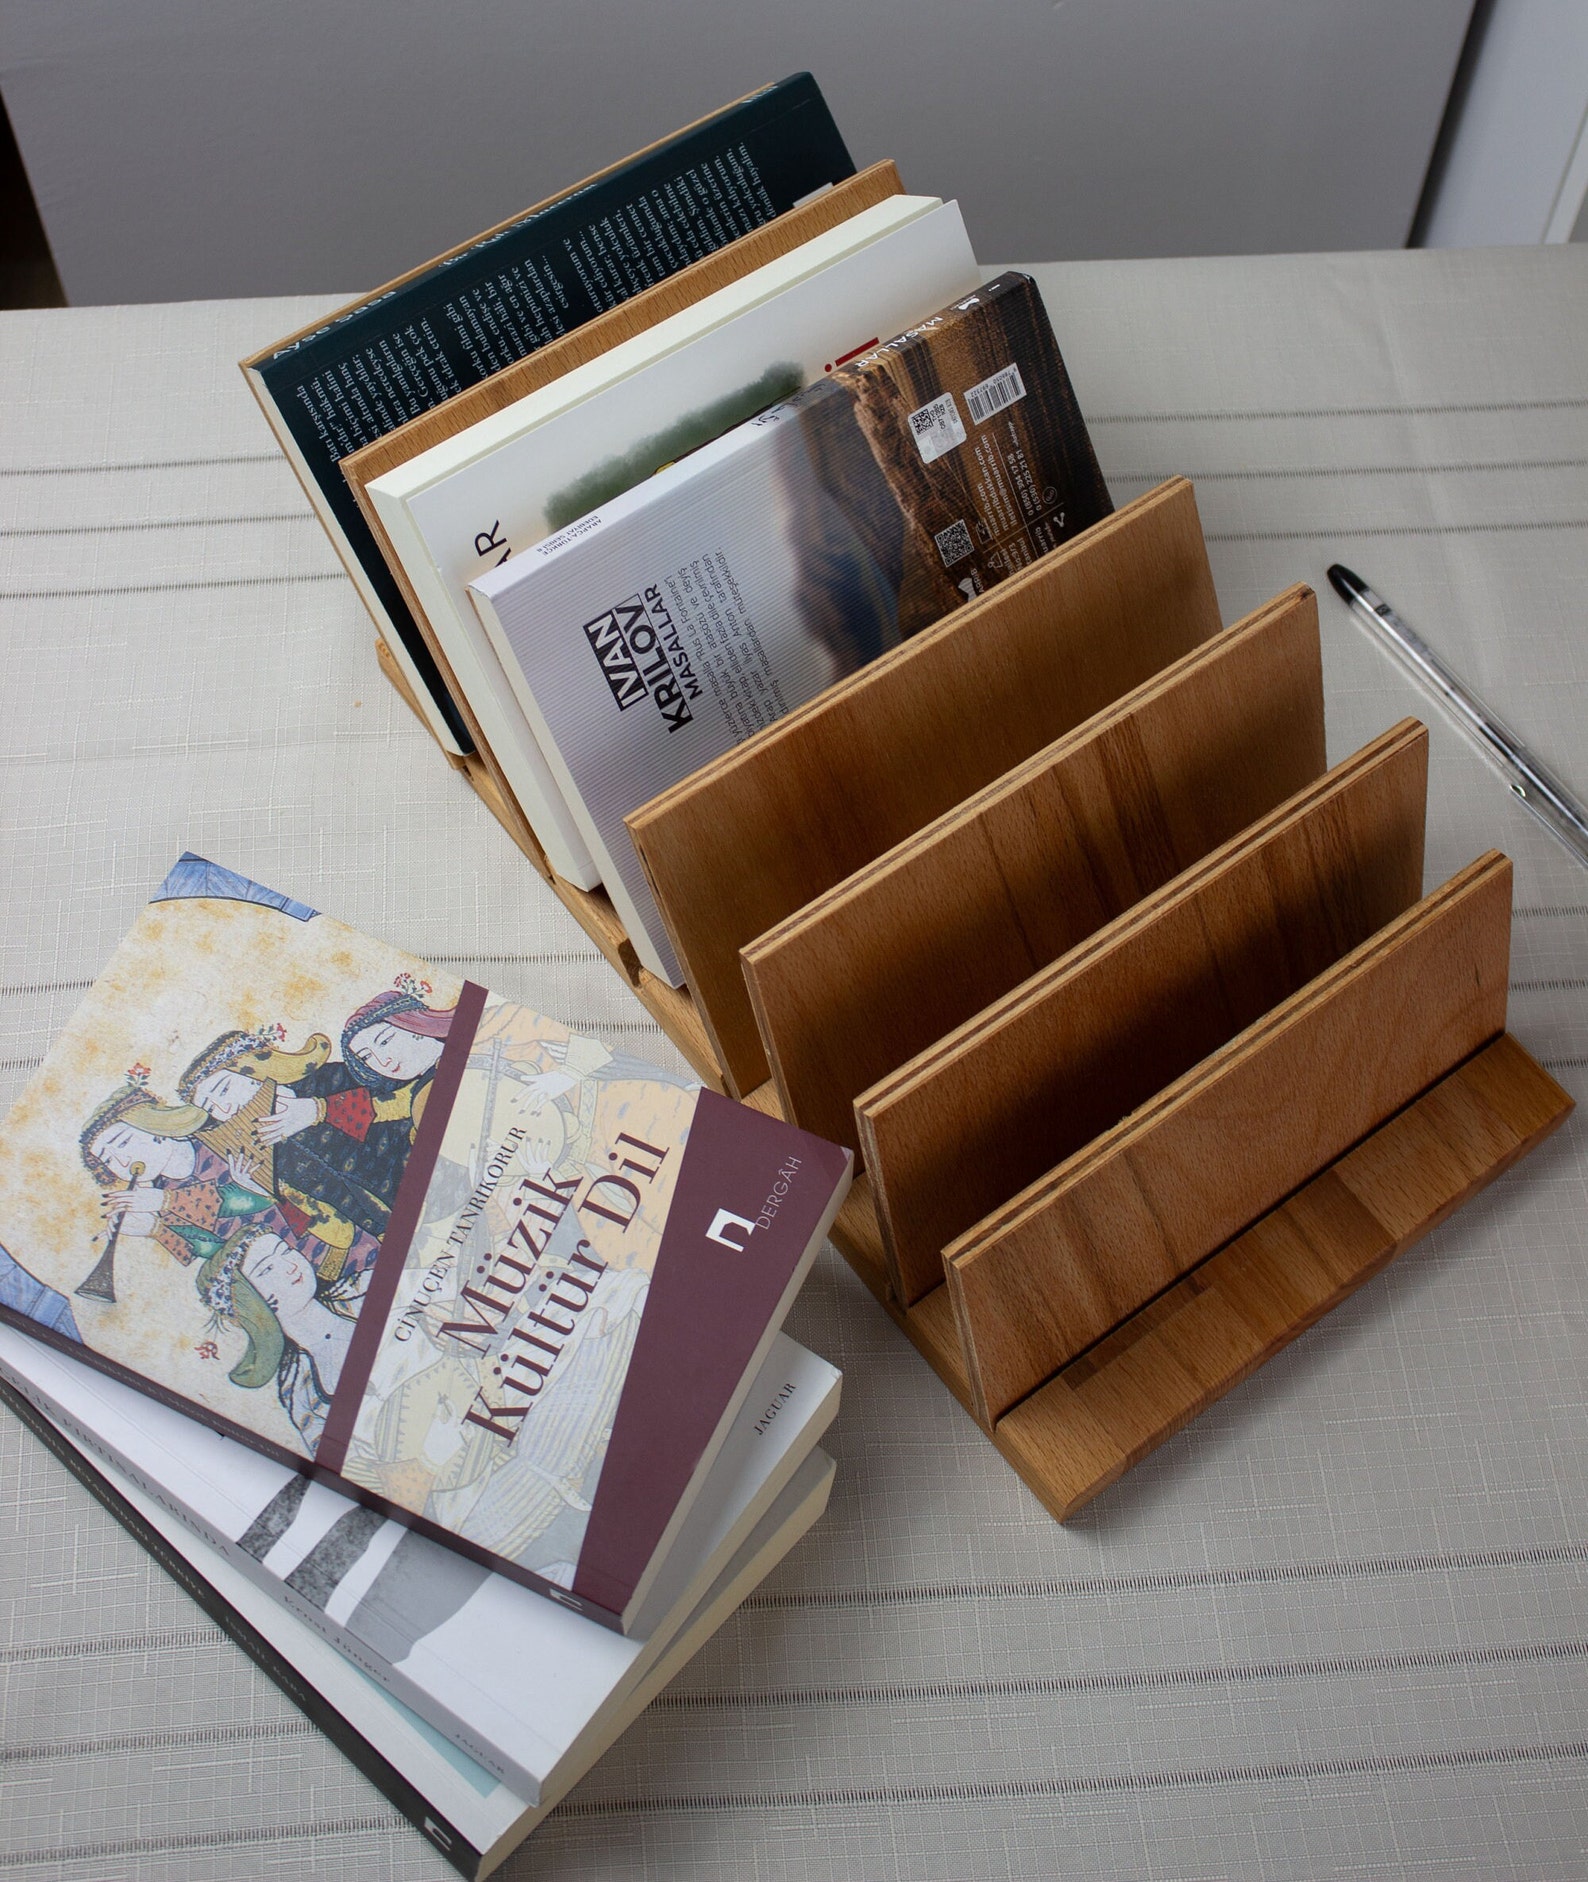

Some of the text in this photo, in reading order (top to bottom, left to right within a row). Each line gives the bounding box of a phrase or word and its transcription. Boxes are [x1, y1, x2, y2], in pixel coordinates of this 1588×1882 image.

[651, 189, 659, 197] o
[673, 175, 699, 216] Şimdiki
[685, 169, 708, 196] güzel
[700, 162, 722, 200] üzerine
[714, 155, 741, 208] kılıyorum.
[726, 148, 760, 209] yolculuğum,
[738, 142, 776, 217] dönük hayalim.
[655, 198, 670, 220] ama
[663, 183, 699, 248] eda edebilme
[702, 197, 709, 205] o
[599, 217, 629, 260] yolculuk
[612, 209, 640, 258] üzümleri,
[626, 203, 666, 277] tam bir cennet
[638, 196, 678, 268] çocukluğumda
[511, 266, 521, 280] ve
[563, 238, 603, 312] oturuyorum ve
[579, 231, 607, 288] ediyorum...
[588, 224, 622, 287] kurar; bense
[472, 288, 482, 302] ve
[484, 282, 497, 299] bir
[524, 259, 555, 313] azaplardan
[542, 255, 569, 308] esirgesin...
[443, 302, 463, 323] gibi
[459, 295, 490, 352] bulamayan
[479, 302, 500, 335] endişe
[497, 274, 540, 343] gibi ve en ağır
[515, 280, 544, 327] hepimizi
[404, 325, 421, 345] çok
[420, 317, 439, 349] ettim.
[454, 324, 473, 350] filmi
[855, 316, 943, 370] MASALLAR
[337, 362, 355, 388] hınç
[352, 354, 382, 399] yaydılar;
[365, 347, 396, 398] neredeyse
[379, 339, 421, 414] Bu yanılgıların
[392, 333, 428, 397] Gerçeğin ise
[415, 346, 434, 367] pek
[434, 350, 454, 379] idrak
[310, 377, 336, 420] hükmü,
[322, 370, 362, 437] biçimi halini
[350, 387, 374, 423] altında
[296, 385, 341, 462] Batı karşısında
[974, 446, 1008, 530] muarribdukkan.com
[979, 482, 1000, 536] muarrib.com
[677, 567, 693, 593] deyiş
[689, 559, 714, 602] çevrilmiş
[690, 596, 700, 610] ve
[707, 602, 720, 621] dile
[724, 607, 742, 637] Anton
[644, 584, 703, 700] MASALLAR
[686, 623, 697, 638] La
[695, 612, 718, 650] atasözü
[715, 620, 729, 644] fazla
[744, 618, 774, 678] masallardan
[588, 614, 645, 706] IVAN
[615, 598, 692, 733] KRILOV
[702, 661, 722, 697] masalla
[713, 653, 724, 668] bir
[724, 642, 743, 675] elliden
[719, 668, 741, 701] büyük
[749, 670, 769, 696] yazar
[718, 697, 743, 737] yüzlerce
[763, 699, 780, 722] Arap
[756, 1155, 803, 1231] DERGÂH
[394, 1125, 527, 1342] CİNUÇEN TANRIKORUR
[435, 1165, 585, 1359] Müzik
[459, 1131, 671, 1448] Kültür Dil
[753, 1381, 797, 1437] JAGUAR
